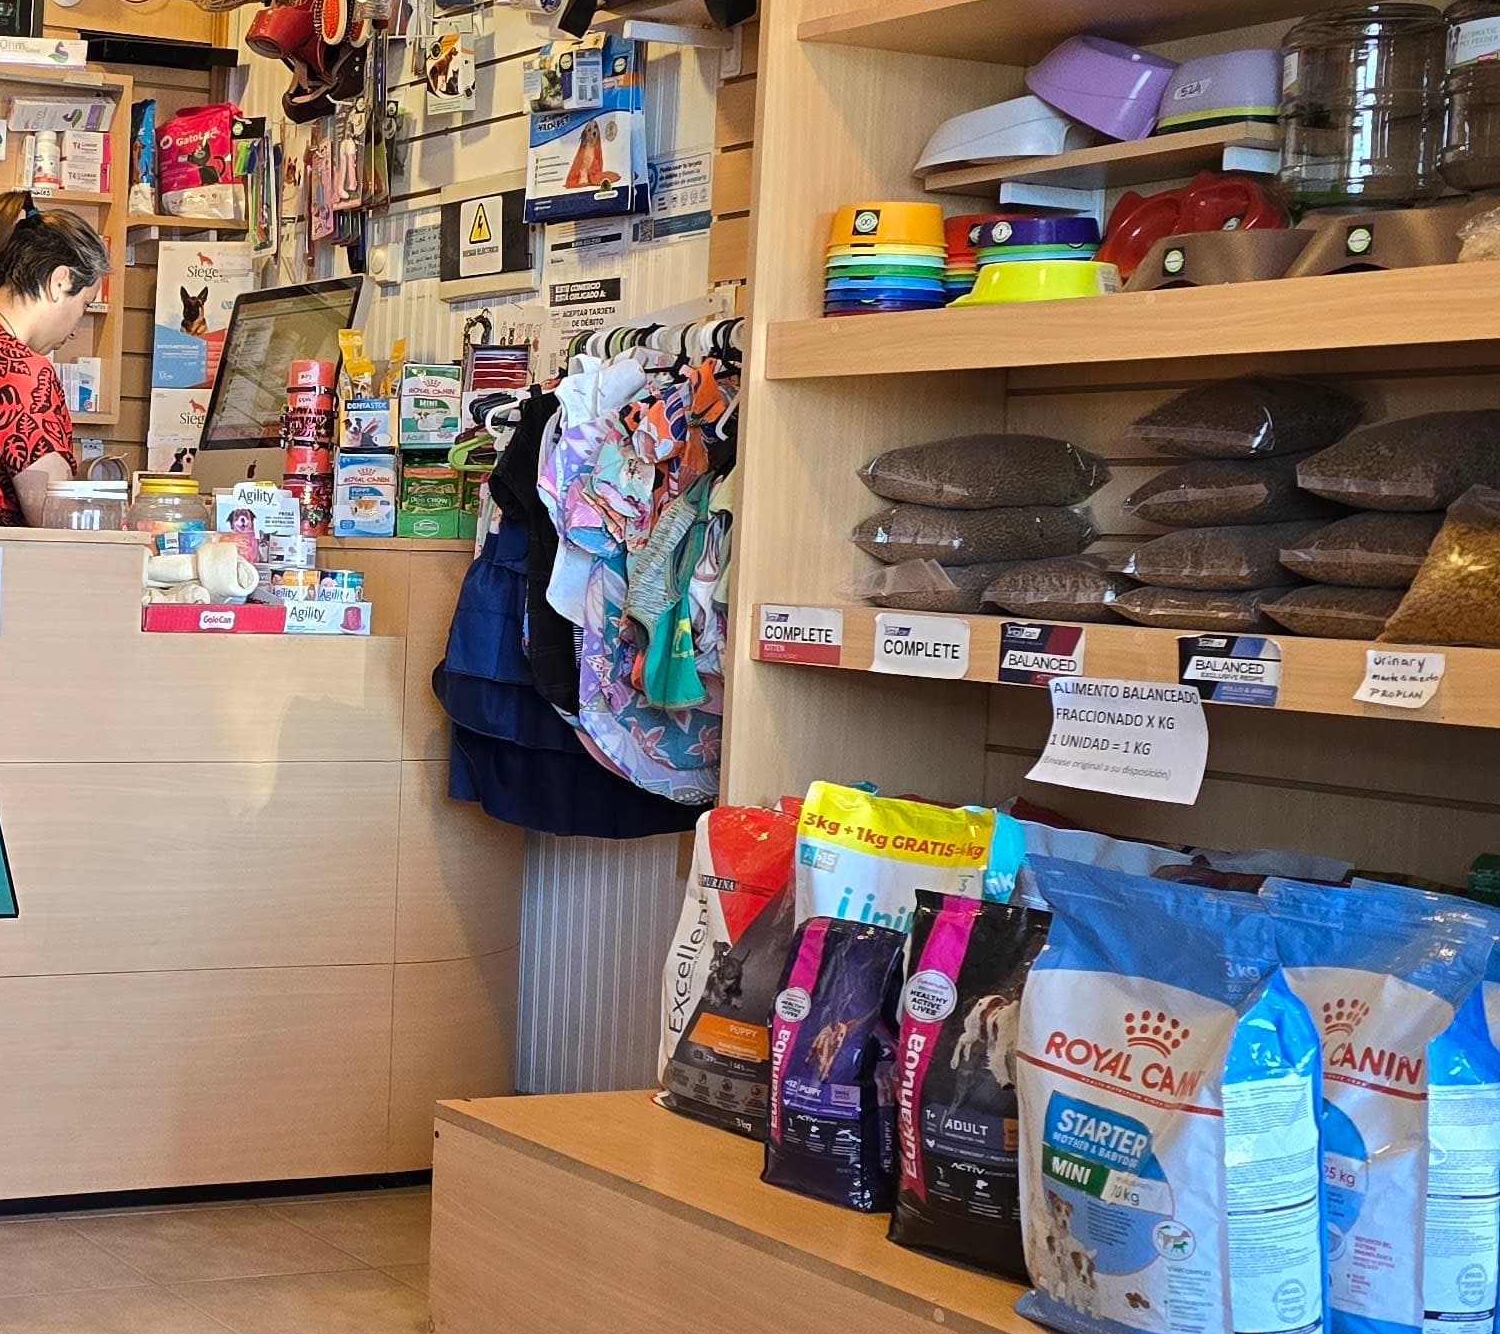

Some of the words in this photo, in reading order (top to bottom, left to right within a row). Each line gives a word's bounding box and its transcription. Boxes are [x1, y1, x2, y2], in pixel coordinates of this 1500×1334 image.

[187, 266, 224, 282] Siege
[562, 308, 588, 318] ACEPTAR
[589, 306, 616, 316] TARJETA
[571, 319, 580, 327] DE
[581, 317, 604, 327] DÉBITO
[179, 412, 206, 428] Sieg
[238, 488, 275, 505] Agility
[289, 606, 326, 623] Agility
[764, 625, 834, 643] COMPLETE
[883, 639, 961, 660] COMPLETE
[1008, 653, 1078, 673] BALANCED
[1195, 659, 1265, 676] BALANCED
[1053, 682, 1119, 699] ALIMENTO
[1122, 685, 1199, 705] BALANCEADO
[1056, 707, 1142, 728] FRACCIONADO
[1146, 716, 1156, 729] X
[1158, 716, 1175, 730] KG
[1049, 733, 1057, 746] 1
[1060, 734, 1109, 751] UNIDAD
[1122, 741, 1130, 754] 1
[1133, 742, 1152, 756] KG
[1072, 758, 1102, 771] original
[1110, 766, 1121, 774] su
[1122, 766, 1172, 780] disposición)
[804, 812, 841, 835] 3kg
[844, 825, 854, 835] +
[856, 825, 888, 850] 1kg
[891, 834, 954, 857] GRATIS
[701, 874, 736, 891] PURINA
[668, 898, 709, 1034] Excellent
[910, 990, 948, 1005] HEALTHY
[911, 998, 941, 1011] ACTIVE
[912, 1005, 937, 1016] LIVES
[729, 1024, 757, 1038] PUPPY
[1045, 1031, 1133, 1083] ROYAL
[1329, 1041, 1424, 1086] CANIN
[735, 1117, 752, 1132] 3kg
[944, 1118, 989, 1136] ADULT
[1057, 1108, 1147, 1159] STARTER
[1053, 1131, 1089, 1151] MOTHER
[1051, 1156, 1092, 1185] MINI
[1338, 1169, 1356, 1188] kg
[1122, 1189, 1140, 1206] kg
